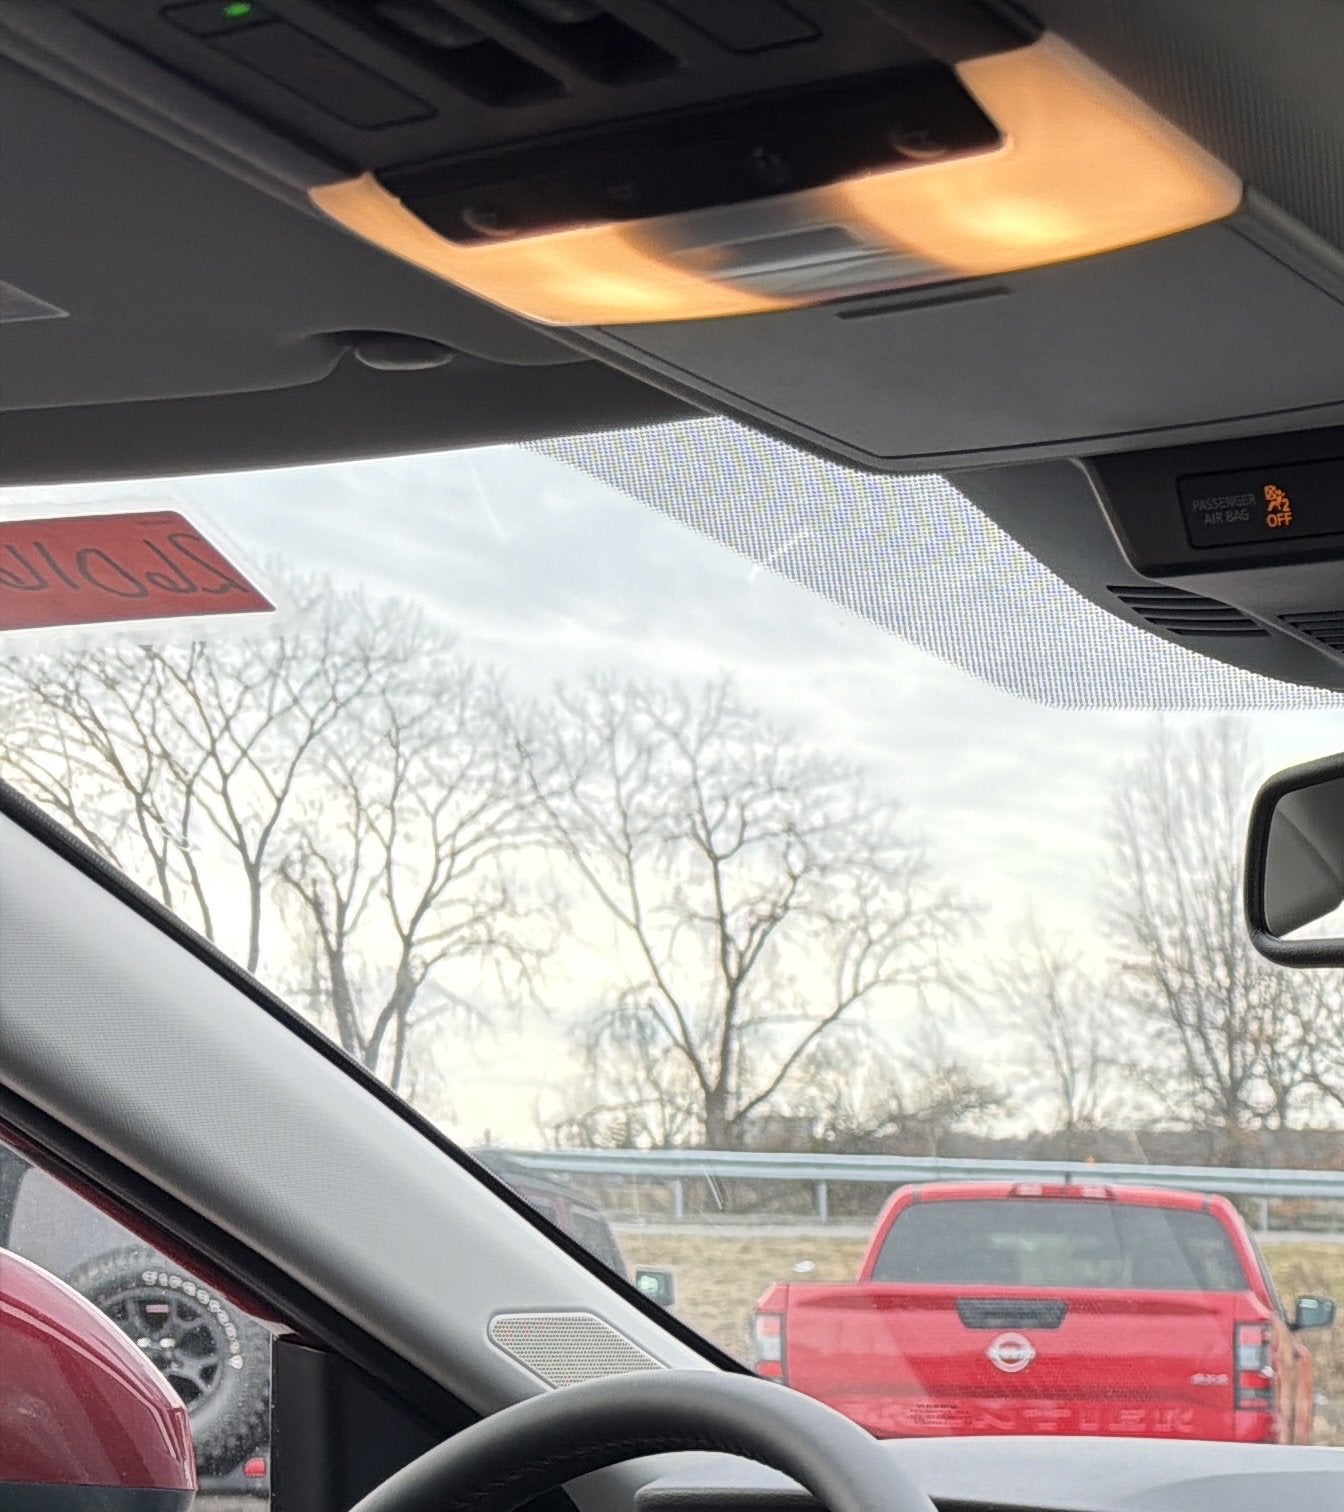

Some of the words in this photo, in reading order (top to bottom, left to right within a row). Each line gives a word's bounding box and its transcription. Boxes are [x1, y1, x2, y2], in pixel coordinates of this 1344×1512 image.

[1192, 494, 1256, 511] PASSENGER
[1204, 512, 1224, 525] AIR
[1226, 509, 1250, 523] BAG
[1266, 512, 1293, 528] OFF
